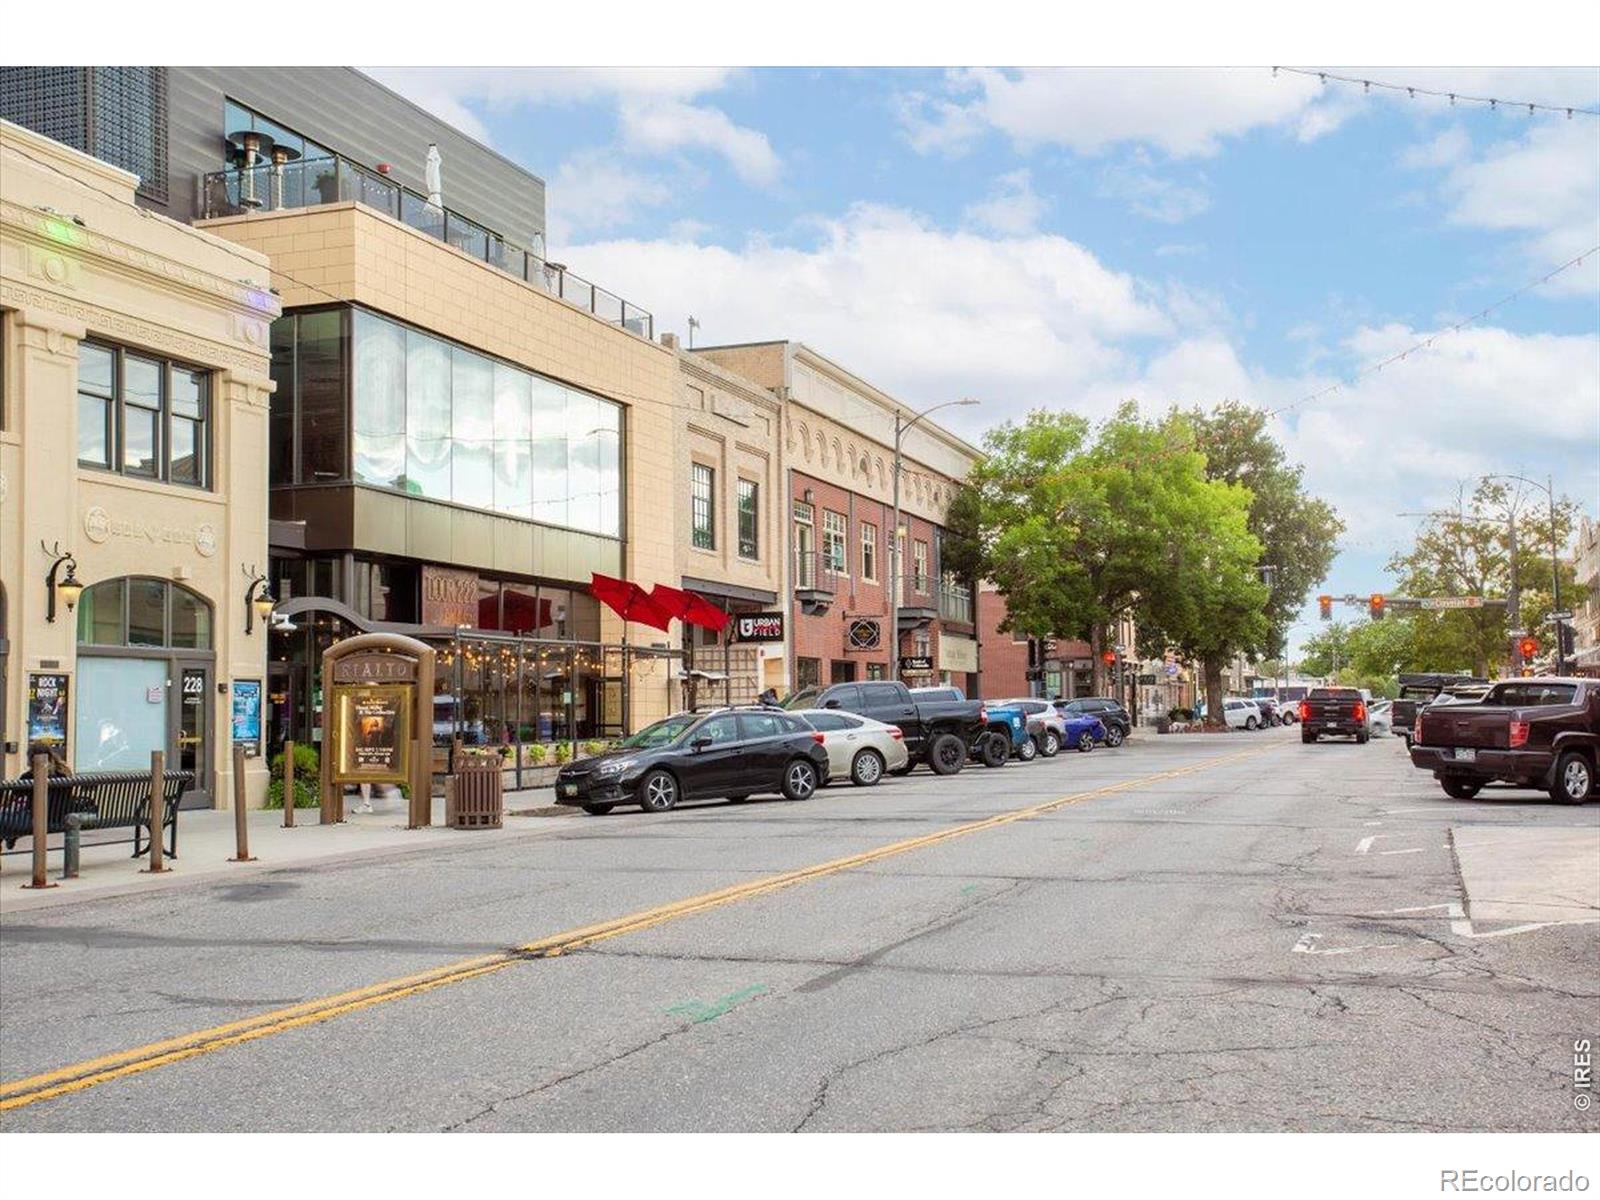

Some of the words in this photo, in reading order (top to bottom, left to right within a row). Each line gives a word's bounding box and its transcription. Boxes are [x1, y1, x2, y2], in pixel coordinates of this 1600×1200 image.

[753, 618, 781, 627] URBAN
[753, 628, 781, 637] FIELD
[341, 662, 407, 677] RIALTO
[38, 677, 57, 687] ROCK
[183, 677, 203, 693] 228
